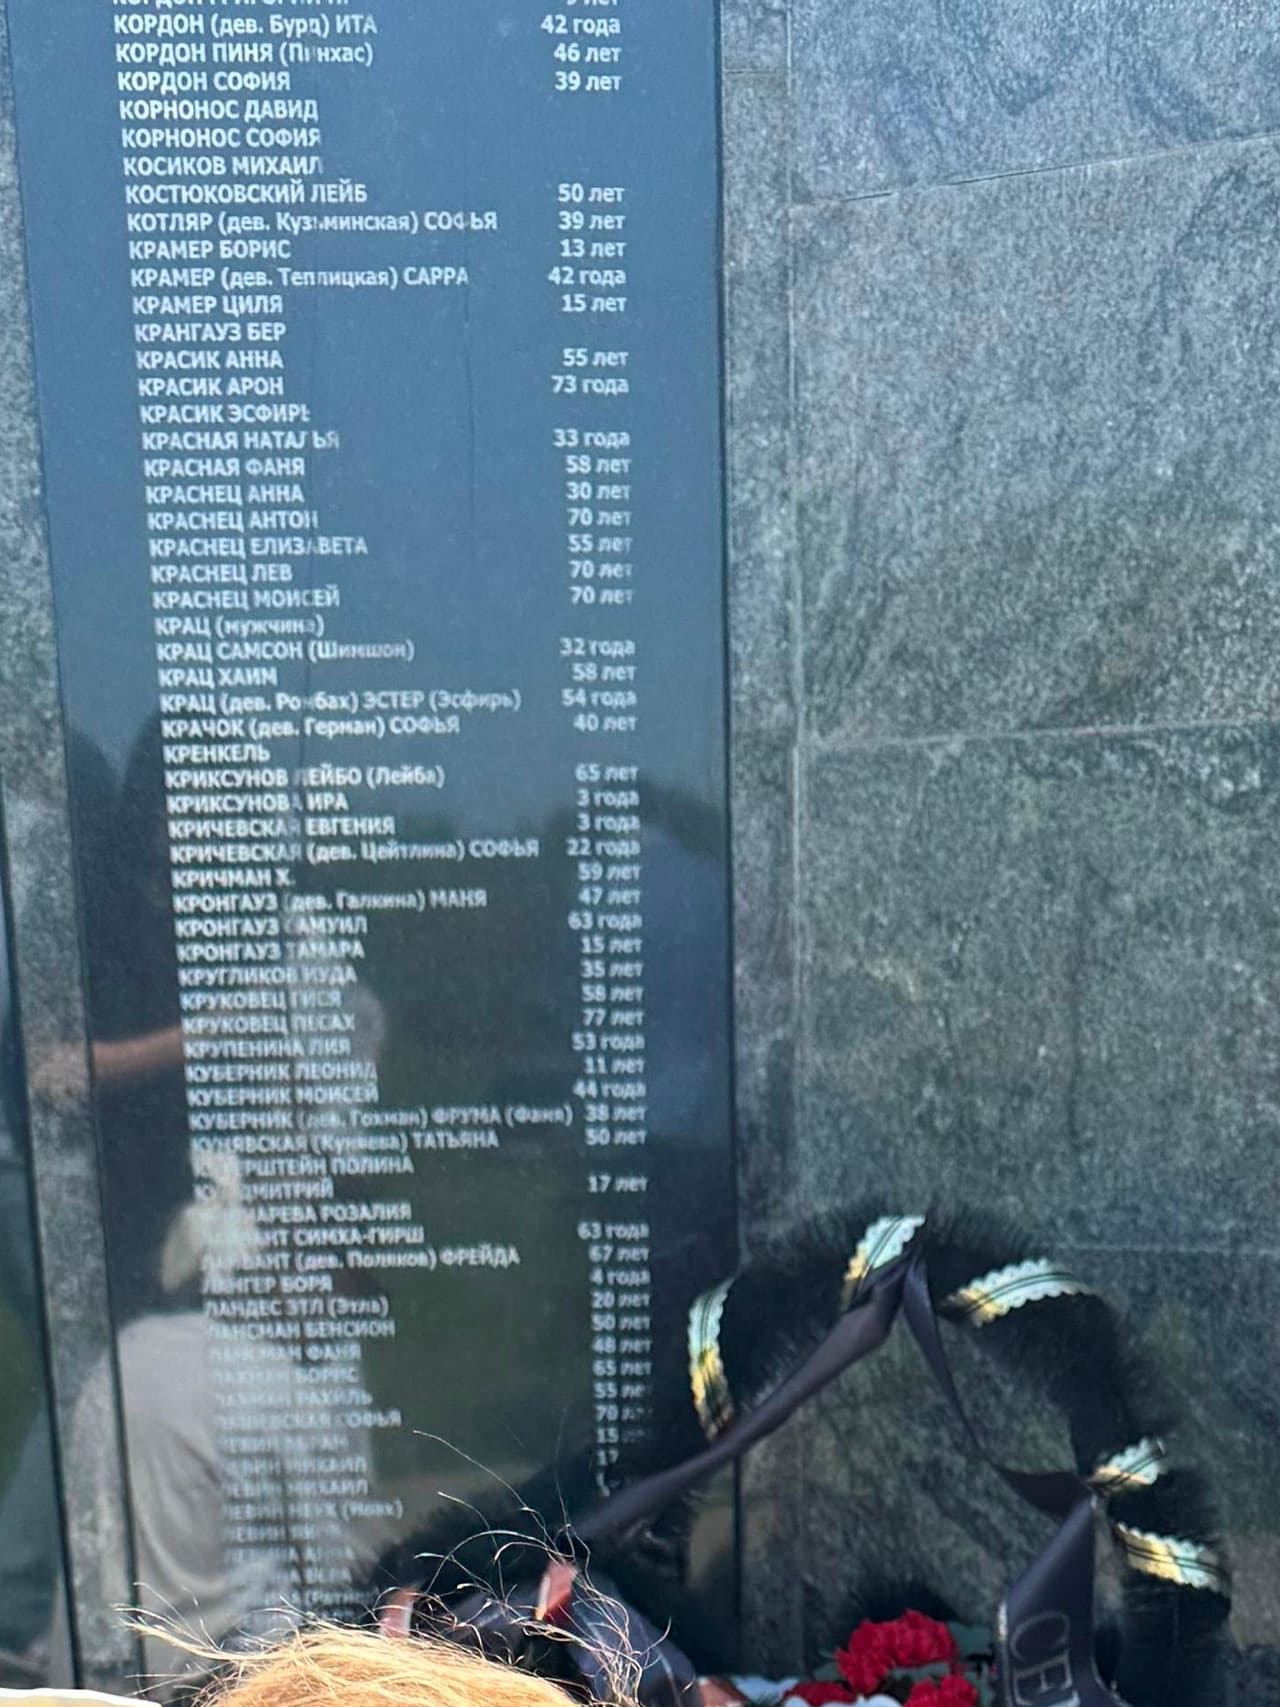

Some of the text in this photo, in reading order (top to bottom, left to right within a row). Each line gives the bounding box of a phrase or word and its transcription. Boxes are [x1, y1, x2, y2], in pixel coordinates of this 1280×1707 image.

[114, 14, 205, 38] КОРДОН
[211, 13, 264, 39] (дев.
[336, 14, 378, 35] ИТА
[541, 14, 568, 34] 42
[573, 18, 621, 37] года
[118, 71, 622, 96] КОРДОН СОФИЯ 39 лет
[120, 100, 319, 123] КОРНОНОС ДАВИД
[122, 128, 321, 148] КОРНОНОС СОФИЯ
[124, 156, 323, 177] КОСИКОВ МИХАИЛ
[126, 178, 625, 204] КОСТЮКОВСКИЙ ЛЕЙБ 50 лет
[129, 239, 626, 260] КРАМЕР БОРИС 13 лет
[133, 294, 627, 318] КРАМЕР ЦИЛЯ 15 лет
[135, 322, 286, 343] КРАНГАУЗ БЕР
[145, 455, 632, 478] КРАСНАЯ ФАНЯ 58 лет
[146, 482, 631, 507] КРАСНЕЦ АННА 30 лет
[164, 744, 270, 764] КРЕНКЕЛЬ
